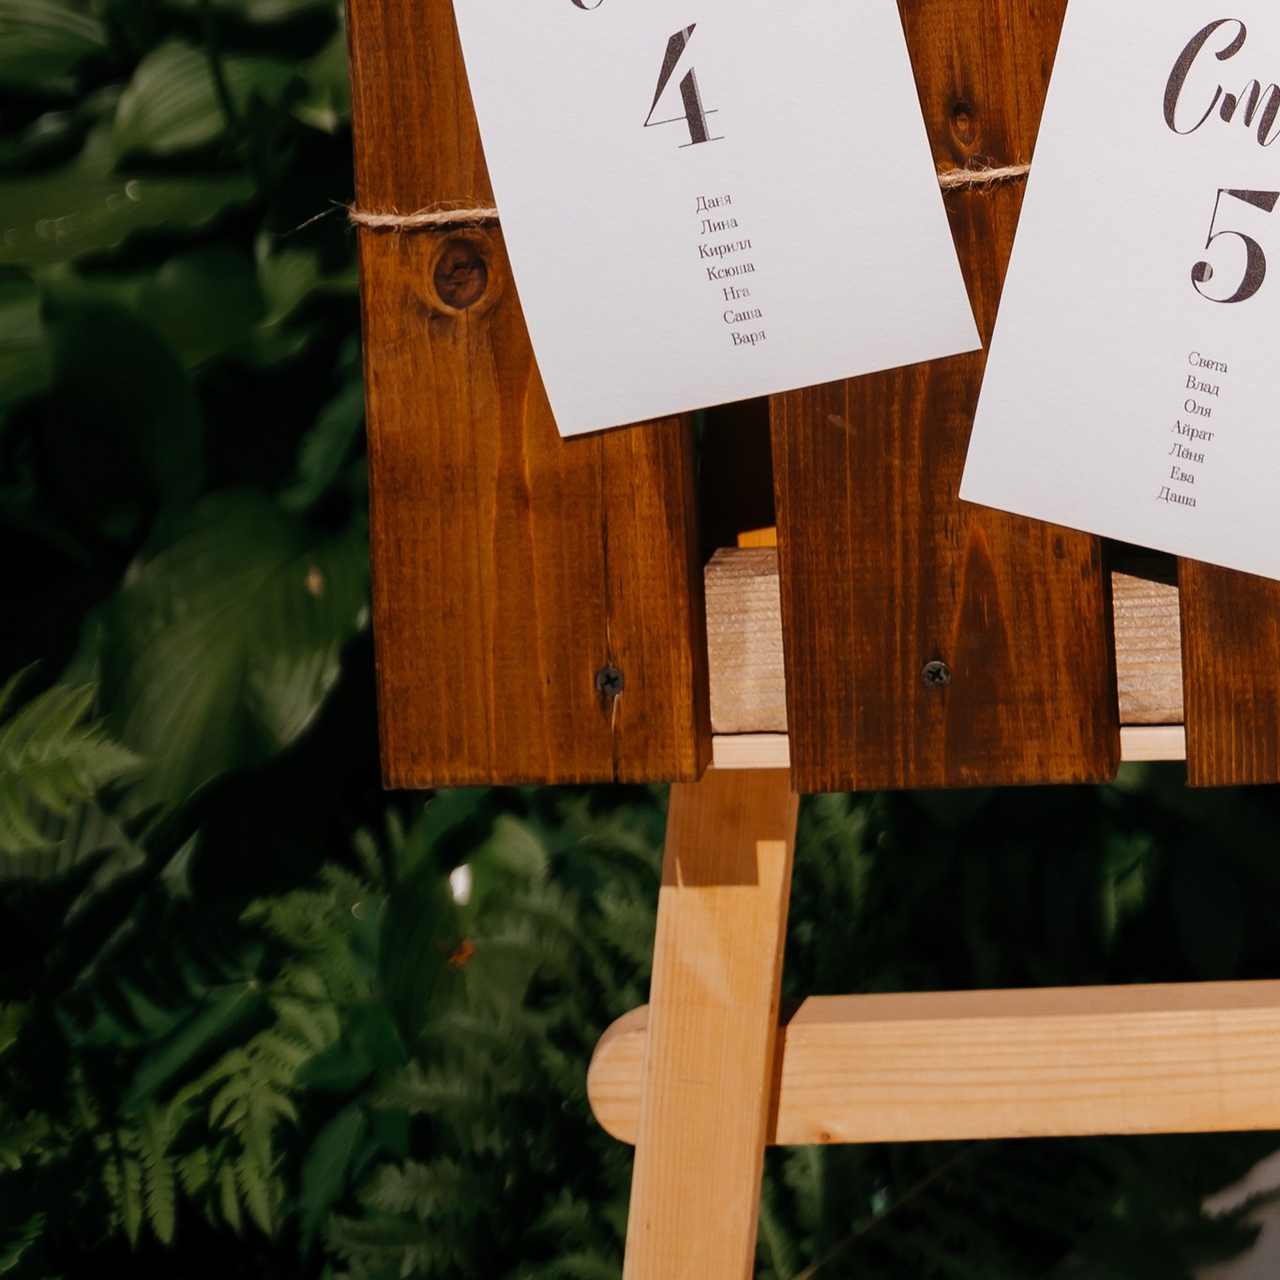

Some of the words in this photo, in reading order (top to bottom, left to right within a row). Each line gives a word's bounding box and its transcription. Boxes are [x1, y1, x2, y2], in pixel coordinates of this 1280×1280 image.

[643, 23, 724, 148] 4
[696, 194, 732, 214] Даня
[700, 217, 738, 235] Лина
[698, 239, 753, 259] Кирилл
[1191, 189, 1280, 303] 5
[706, 262, 755, 281] Ксюша
[723, 308, 763, 325] Саша
[731, 330, 767, 346] Варя
[1188, 351, 1228, 373] Света
[1185, 375, 1220, 397] Влад
[1184, 398, 1212, 418] Оля
[1171, 419, 1215, 442] Айрат
[1170, 466, 1195, 484] Ева
[1156, 486, 1197, 507] Даша
